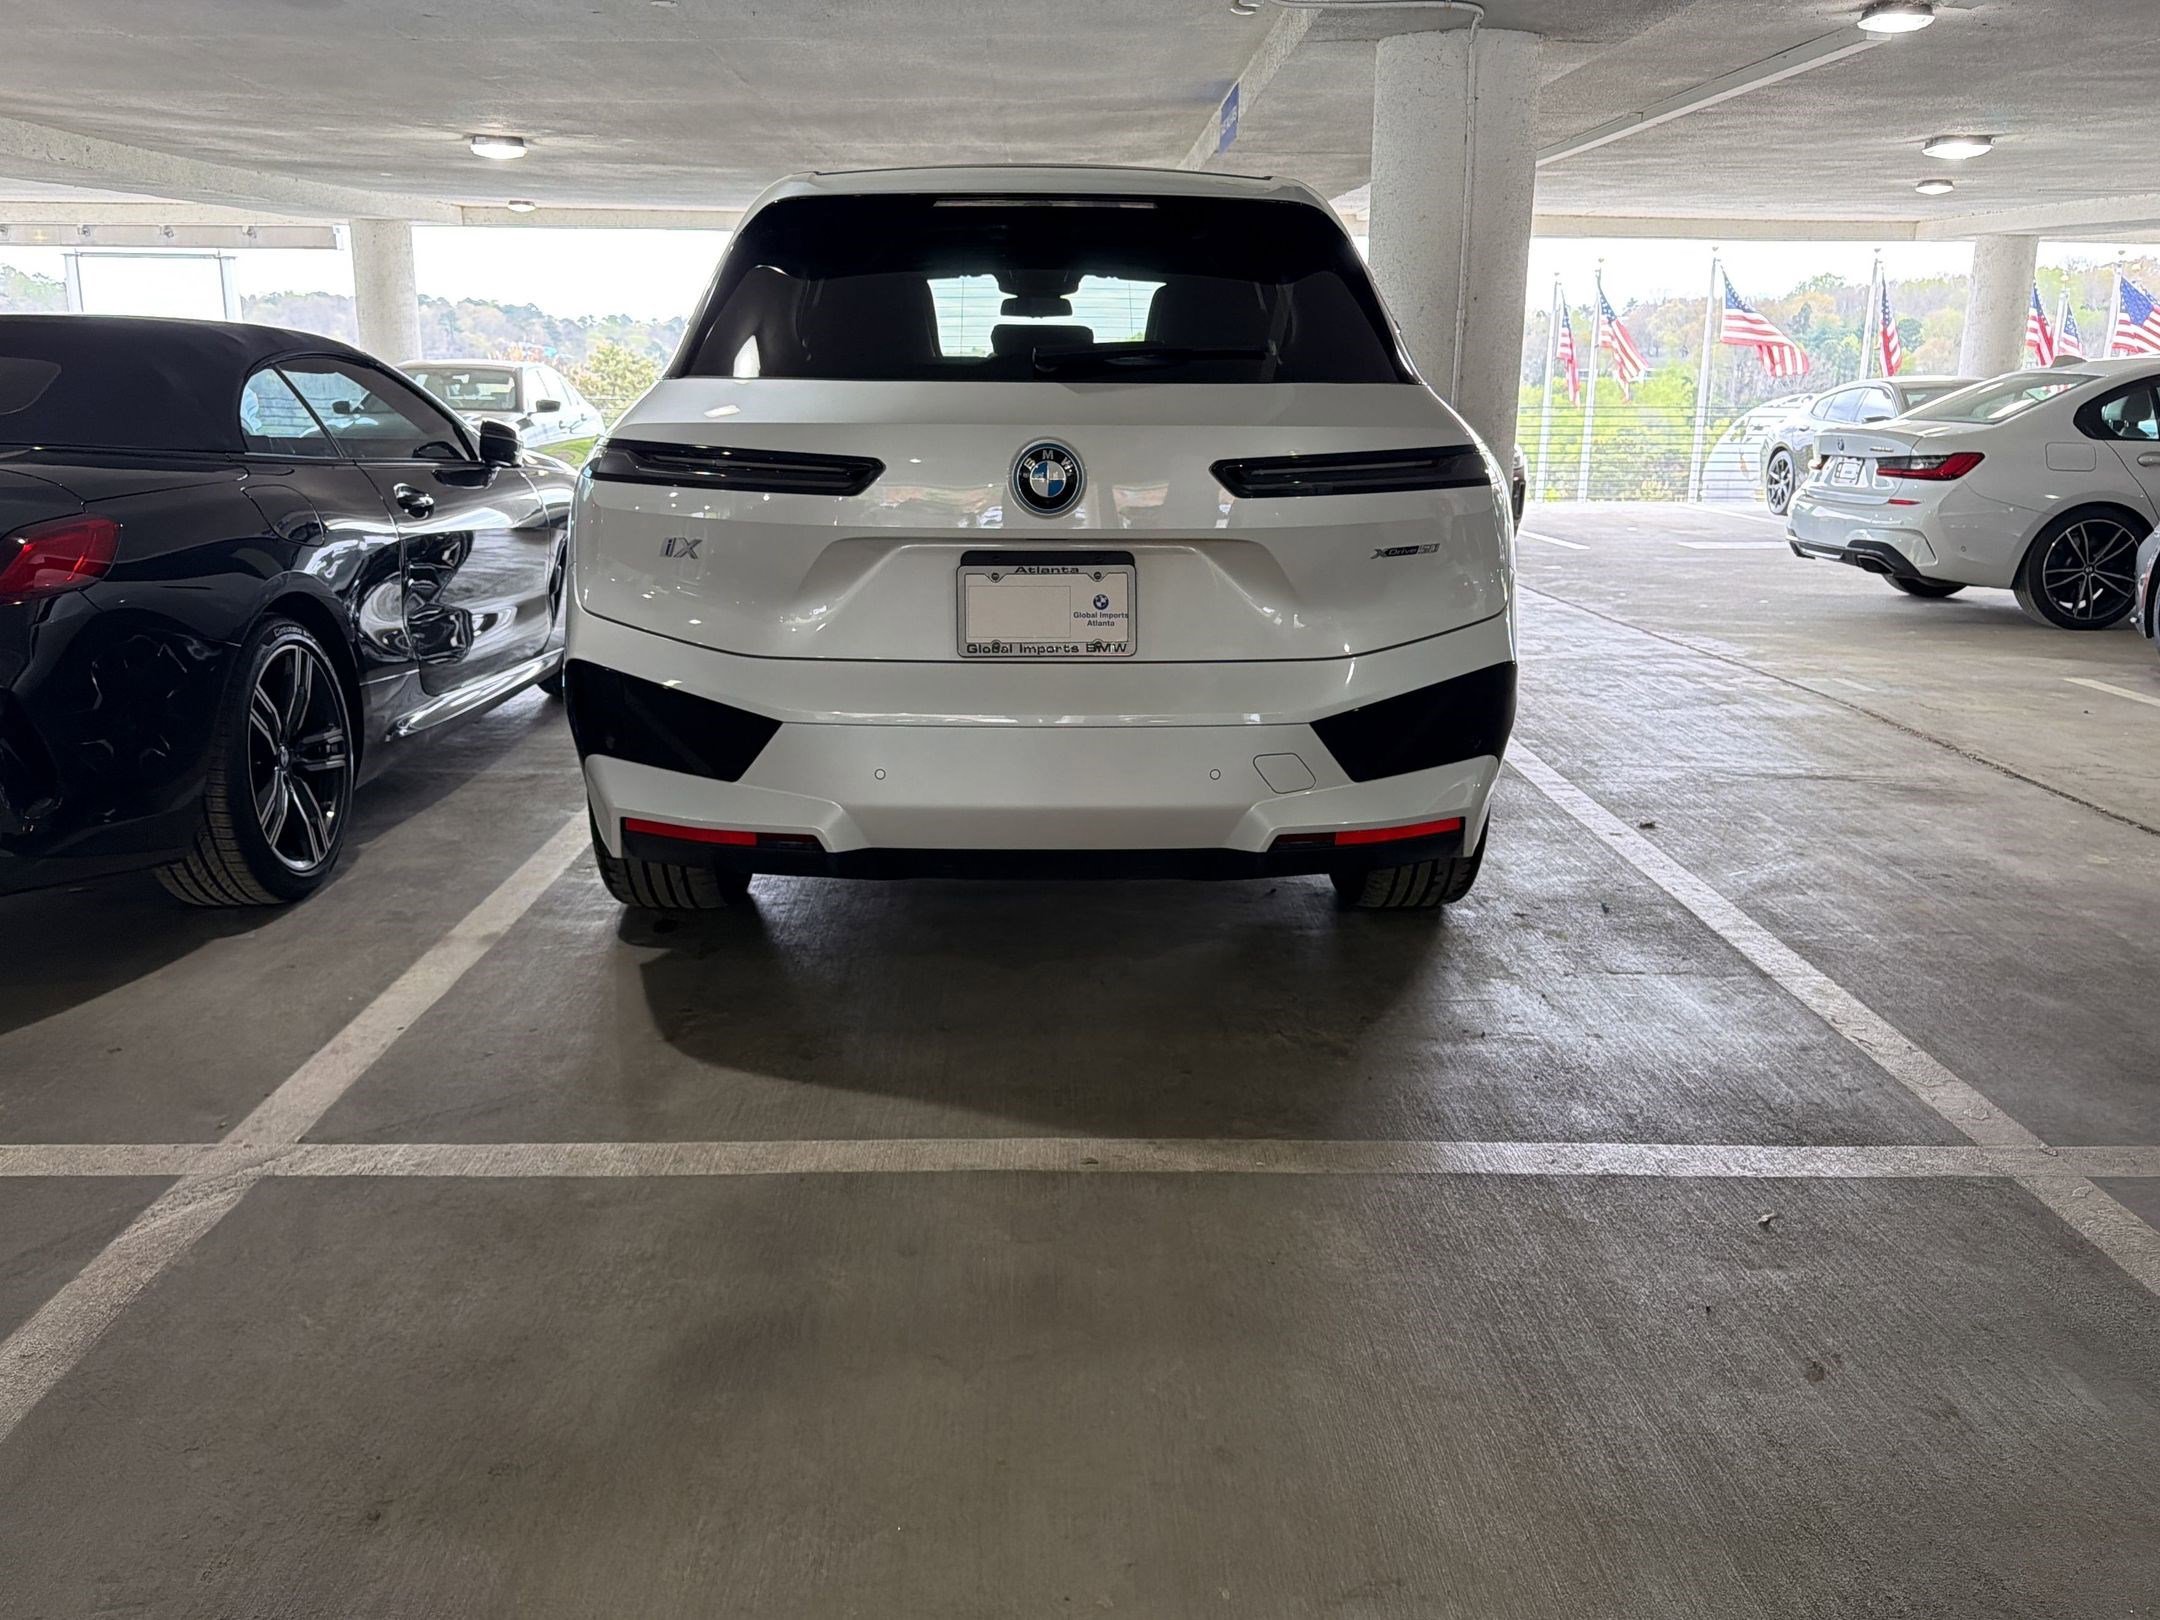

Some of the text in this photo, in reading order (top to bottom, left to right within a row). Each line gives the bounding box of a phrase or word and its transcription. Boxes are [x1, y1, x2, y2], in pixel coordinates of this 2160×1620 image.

[1023, 449, 1073, 470] BMW
[660, 537, 702, 560] iX
[1014, 566, 1080, 574] Atlanta
[1073, 611, 1129, 620] Global Imports
[1087, 619, 1116, 627] Atlanta
[966, 643, 1127, 655] Global Imports BMW
